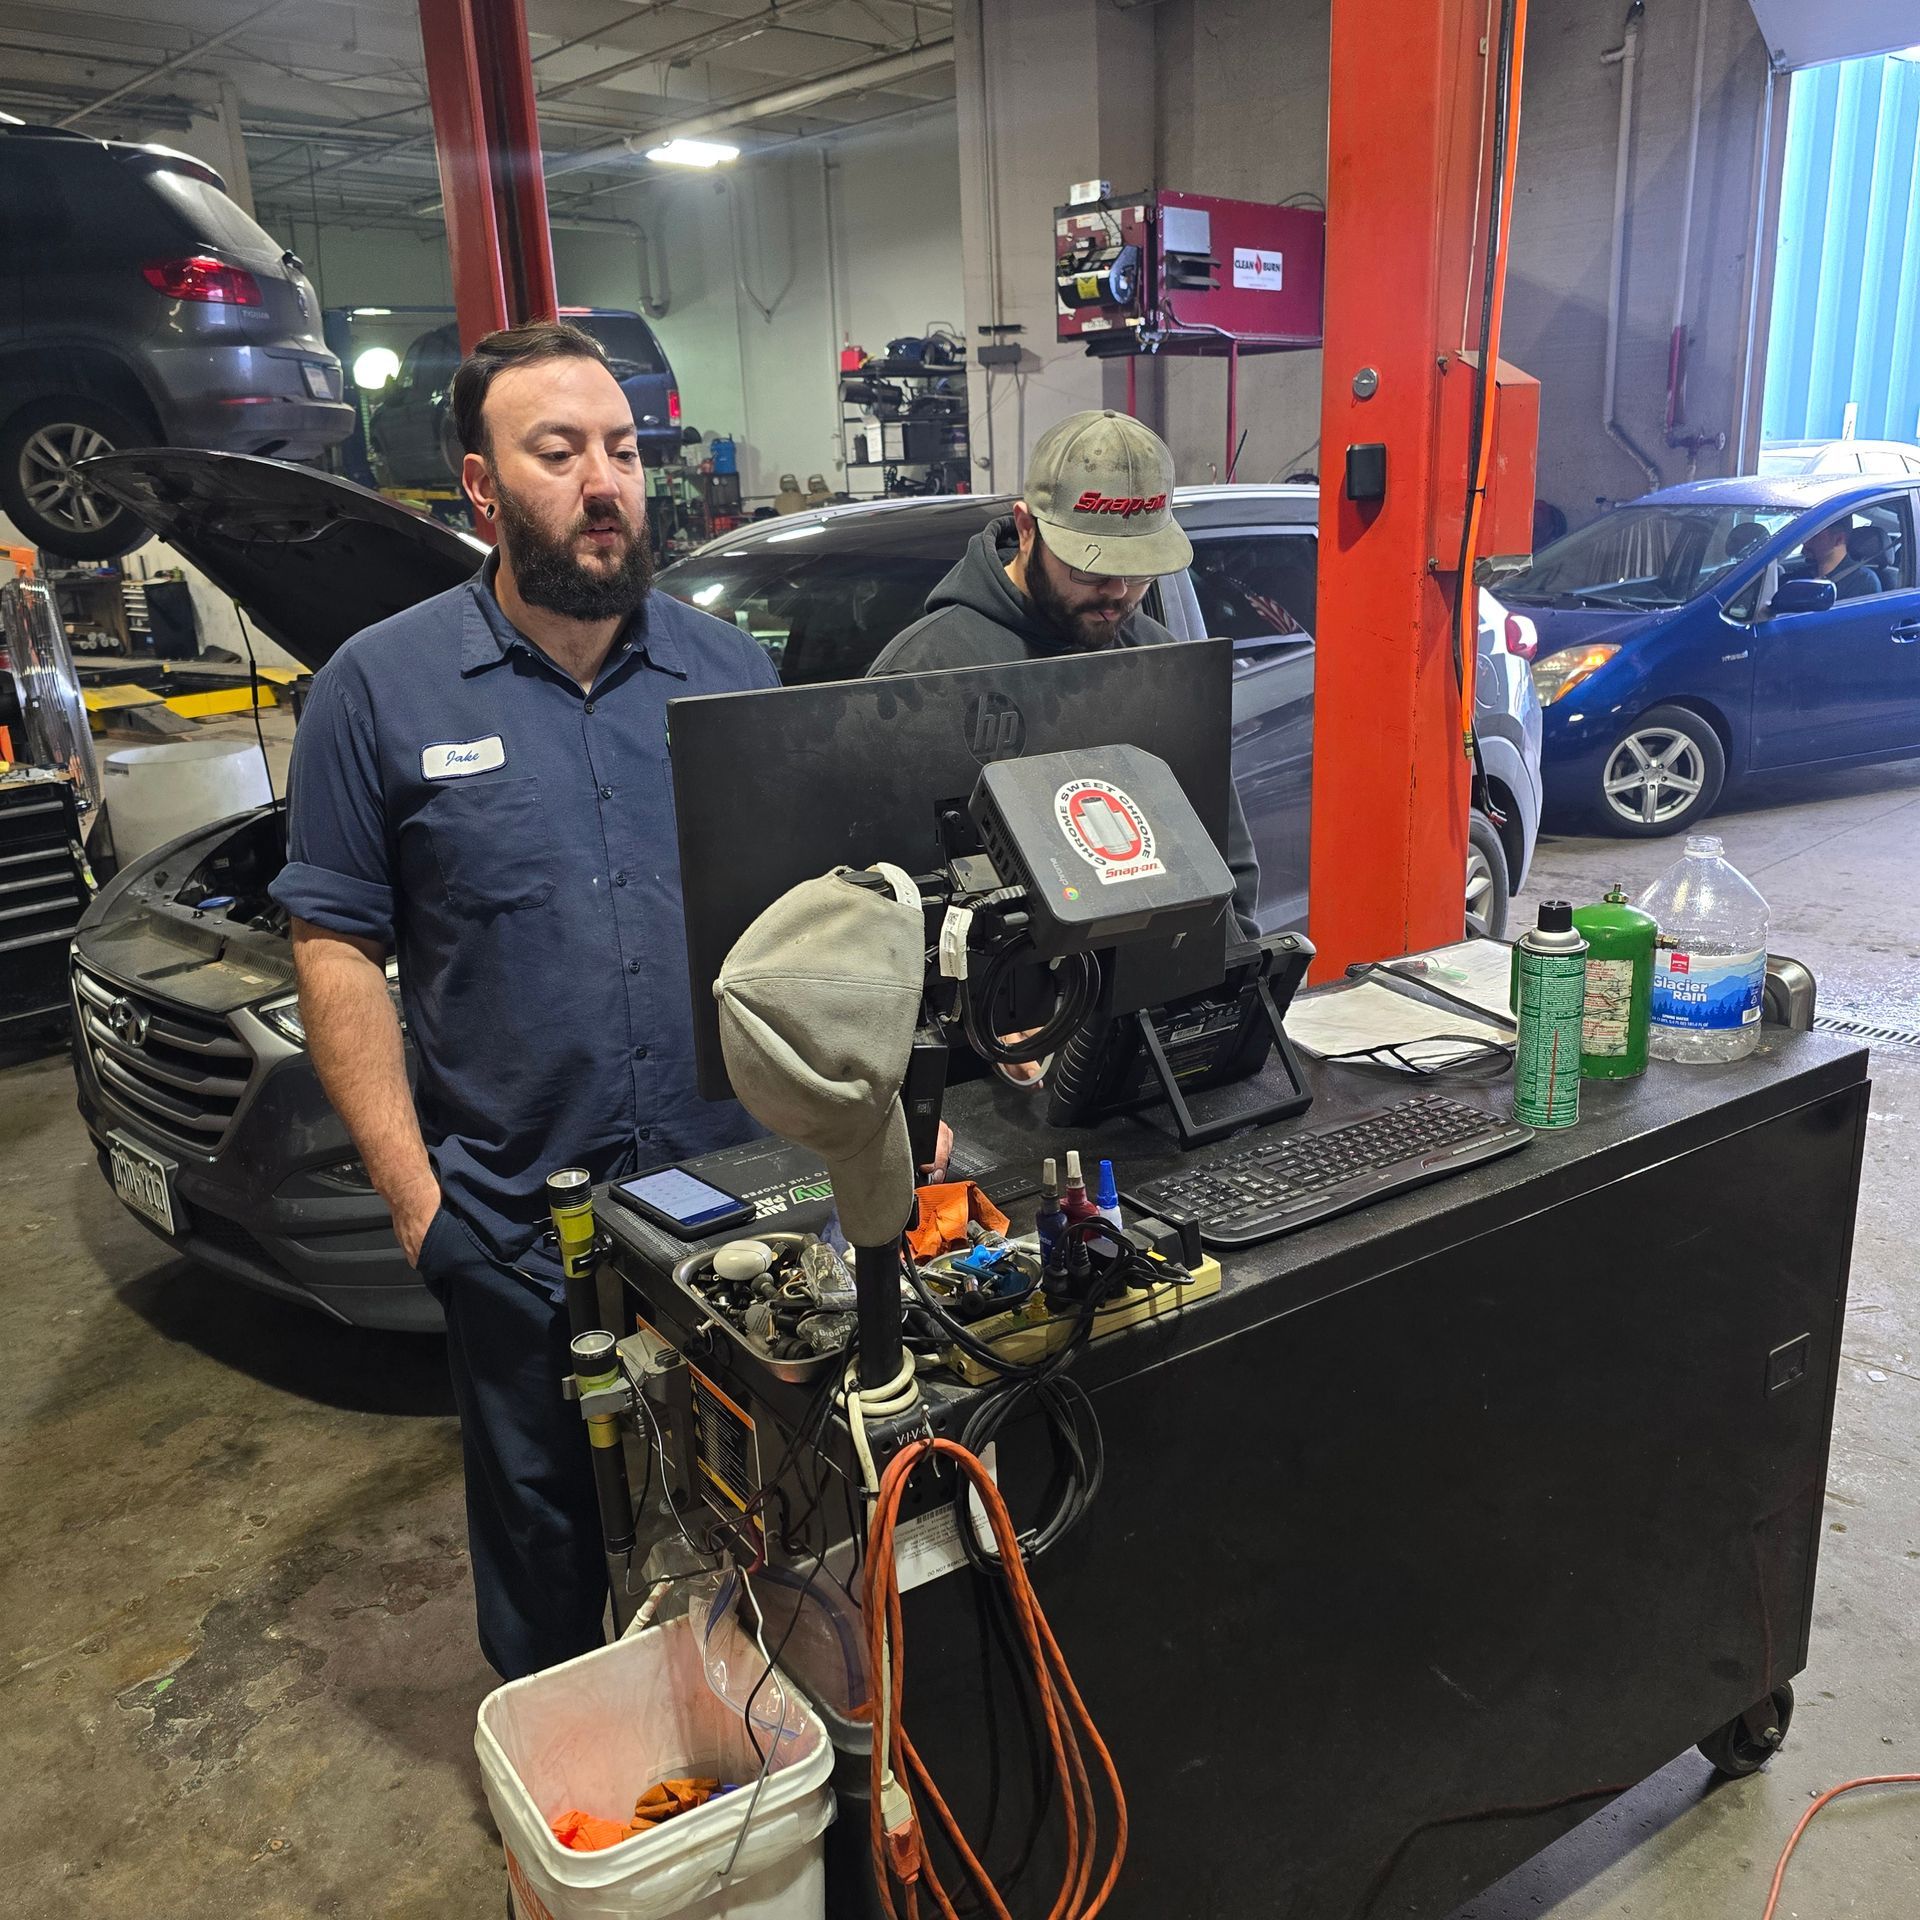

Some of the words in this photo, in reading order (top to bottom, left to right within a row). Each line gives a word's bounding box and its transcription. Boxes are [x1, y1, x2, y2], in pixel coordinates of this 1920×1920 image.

[1234, 259, 1254, 270] CLEAN
[1263, 262, 1281, 272] BURN
[973, 692, 1019, 761] hp
[445, 750, 480, 767] Jake
[1060, 781, 1116, 801] SWEET
[1119, 795, 1151, 858] CHROME
[1059, 805, 1107, 866] CHROME
[1105, 862, 1158, 879] Snap-on
[1653, 975, 1708, 993] Glacier
[1673, 990, 1707, 1005] Rain
[789, 1176, 812, 1185] THE
[741, 1183, 787, 1199] PROFES
[755, 1202, 788, 1219] AUT
